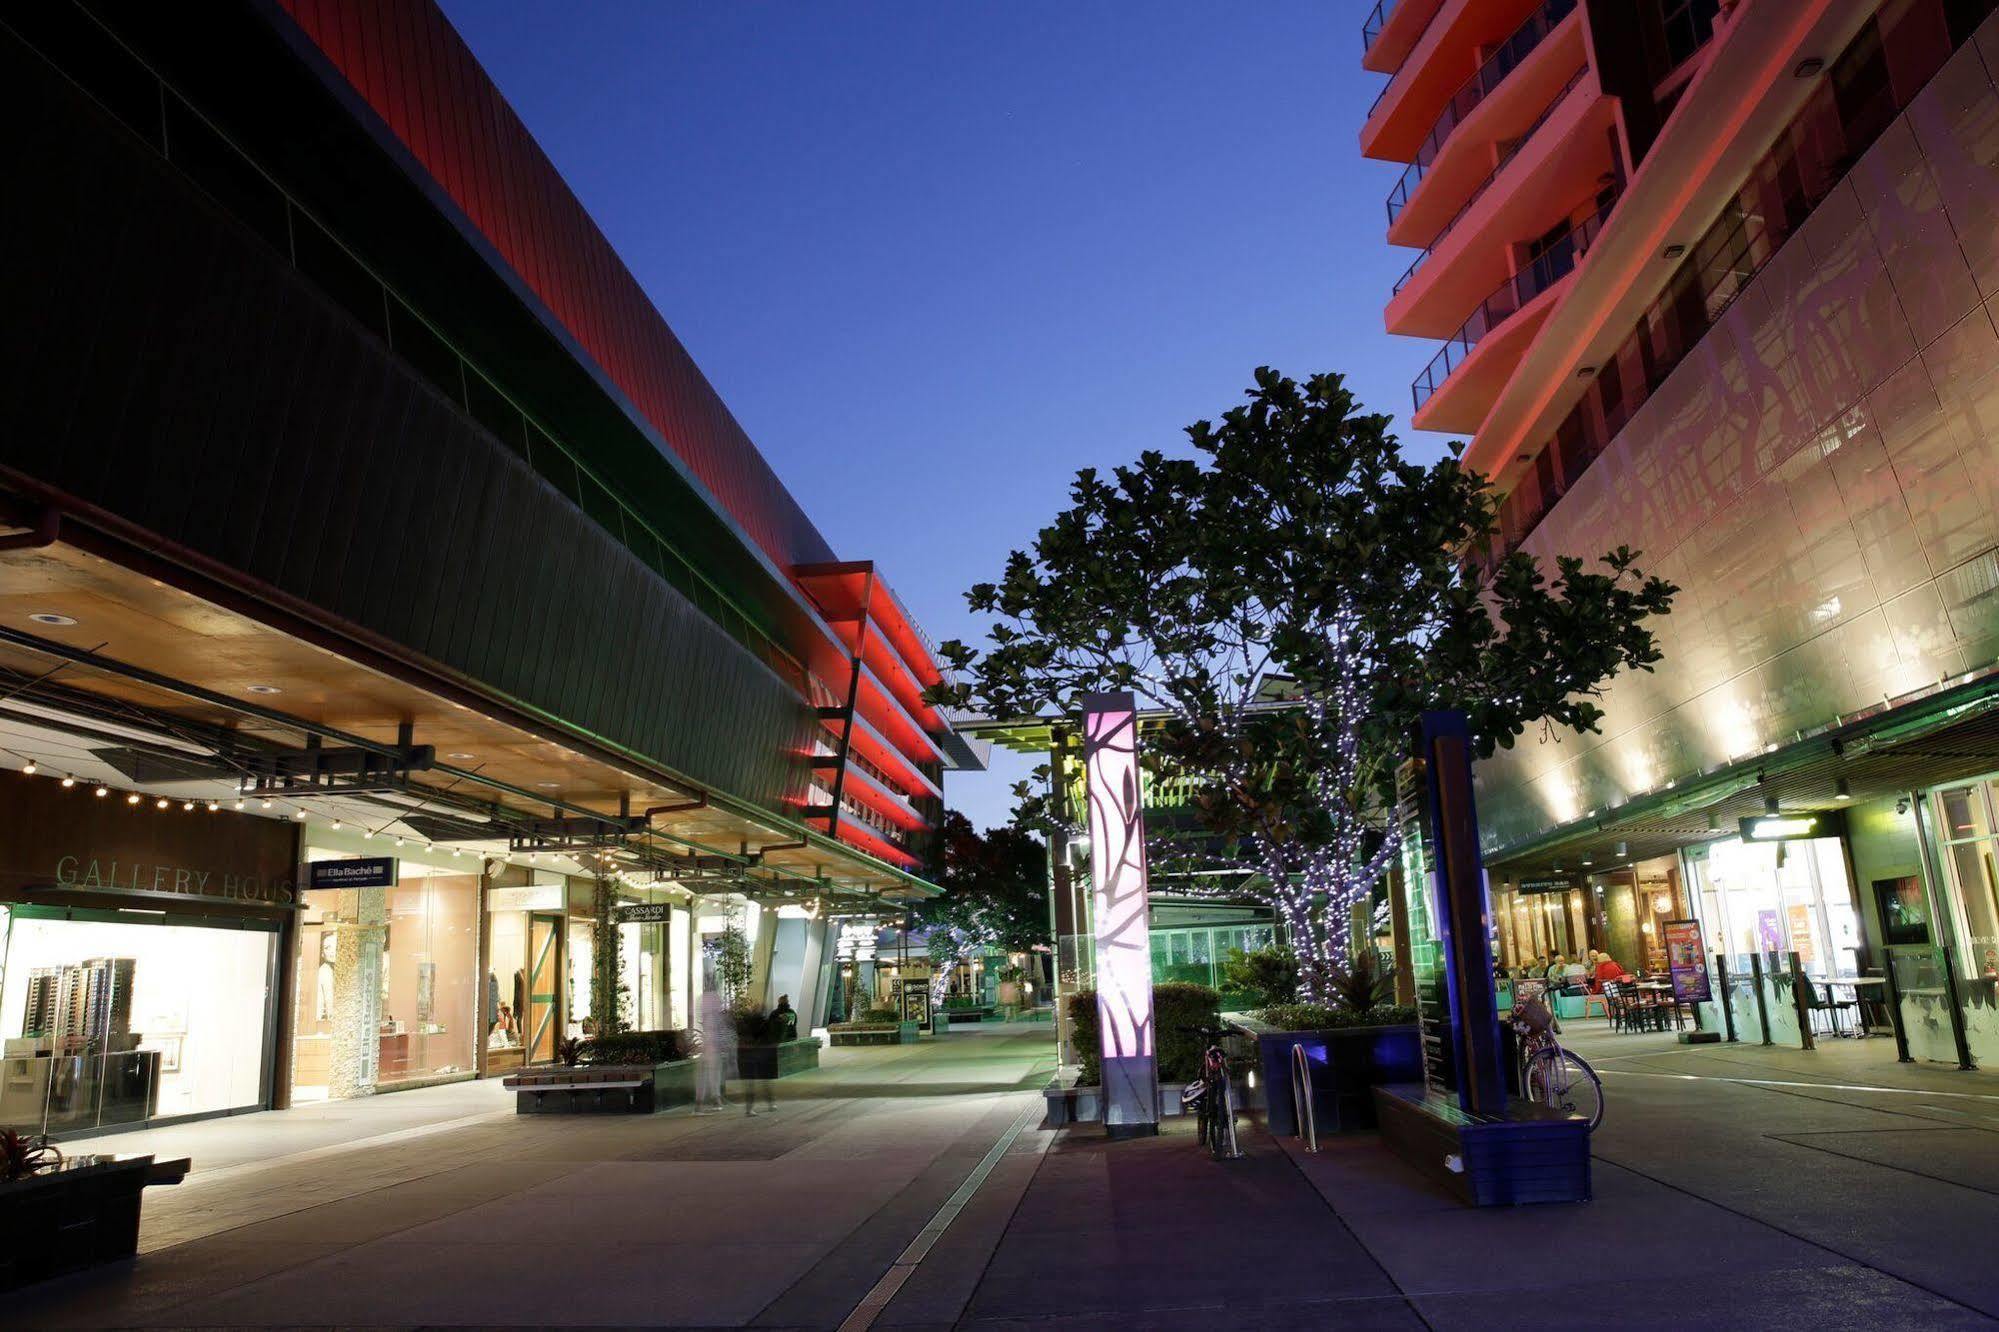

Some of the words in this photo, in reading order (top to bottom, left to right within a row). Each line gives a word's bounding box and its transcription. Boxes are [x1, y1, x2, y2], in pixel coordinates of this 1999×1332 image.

[56, 855, 211, 896] GALLERY
[223, 874, 298, 904] HOUS
[327, 868, 343, 877] Ella
